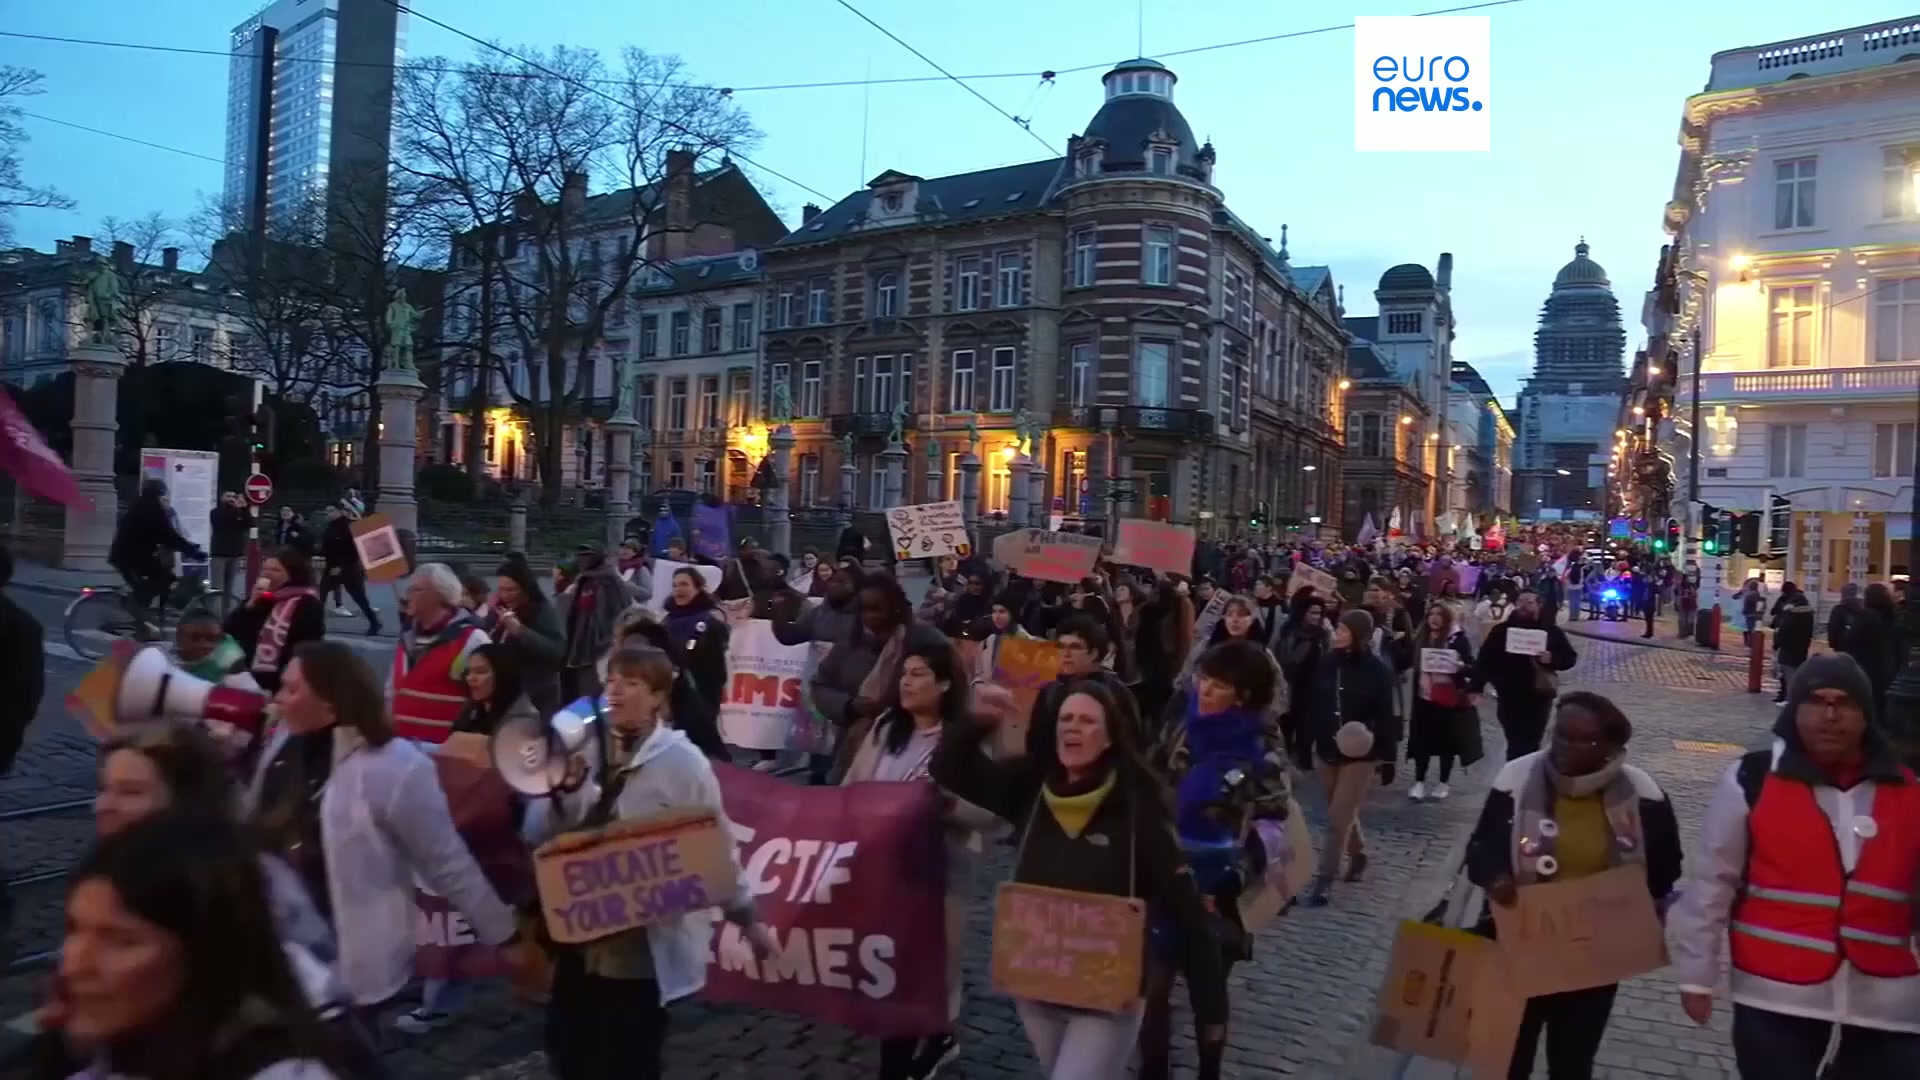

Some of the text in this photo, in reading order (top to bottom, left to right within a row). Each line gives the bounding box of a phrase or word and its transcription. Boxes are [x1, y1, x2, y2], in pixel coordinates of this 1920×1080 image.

[721, 672, 803, 709] IMS
[563, 839, 683, 897] EDUCATE
[552, 893, 631, 938] YOUR
